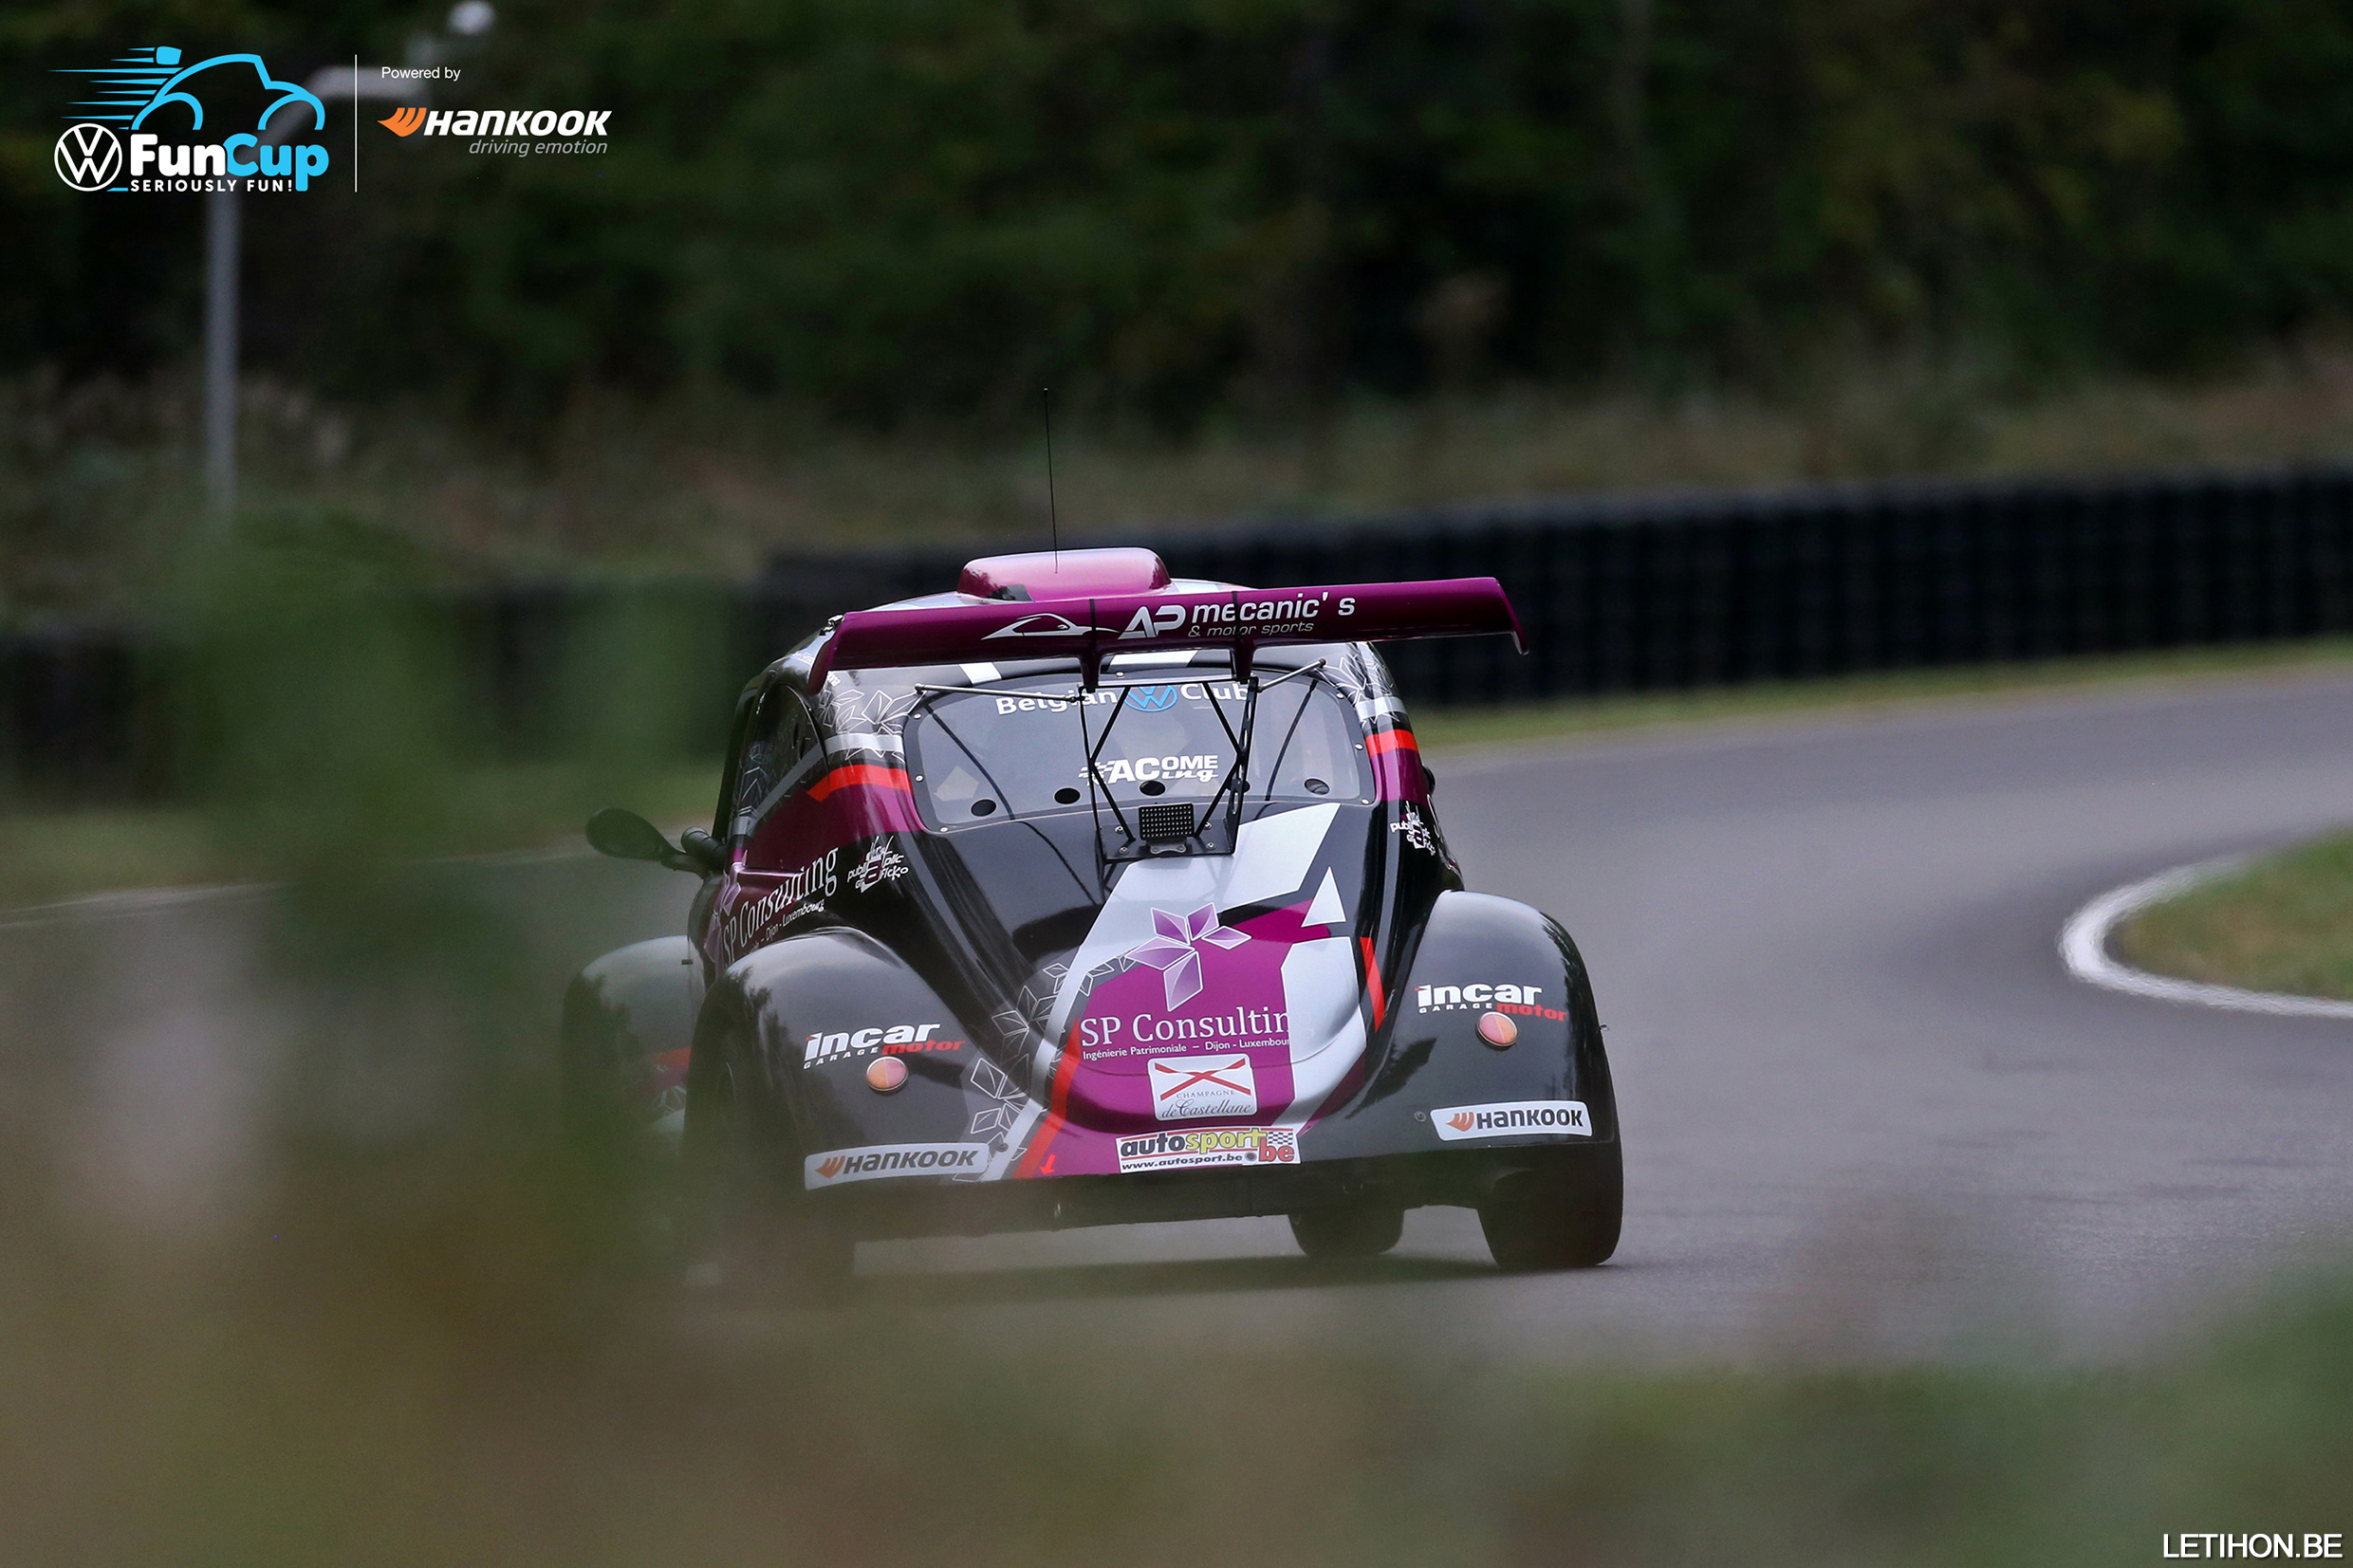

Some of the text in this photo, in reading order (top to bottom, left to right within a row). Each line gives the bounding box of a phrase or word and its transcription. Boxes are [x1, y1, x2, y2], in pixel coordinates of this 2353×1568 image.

[1118, 605, 1187, 640] AP
[1261, 621, 1314, 636] sports
[995, 688, 1118, 715] Belgian
[723, 916, 737, 966] SP
[1416, 983, 1543, 1007] incar
[1418, 1003, 1567, 1022] GARAGE motor
[805, 1024, 940, 1061] incar
[1080, 1015, 1122, 1047] SP
[803, 1040, 966, 1070] GARAGE motor
[1083, 1048, 1127, 1061] Ingénierie
[1130, 1043, 1187, 1056] Patrimoniale
[1205, 1040, 1231, 1051] Dijon
[1176, 1090, 1235, 1099] CHAMPAGNE
[1121, 1127, 1268, 1156] autosport
